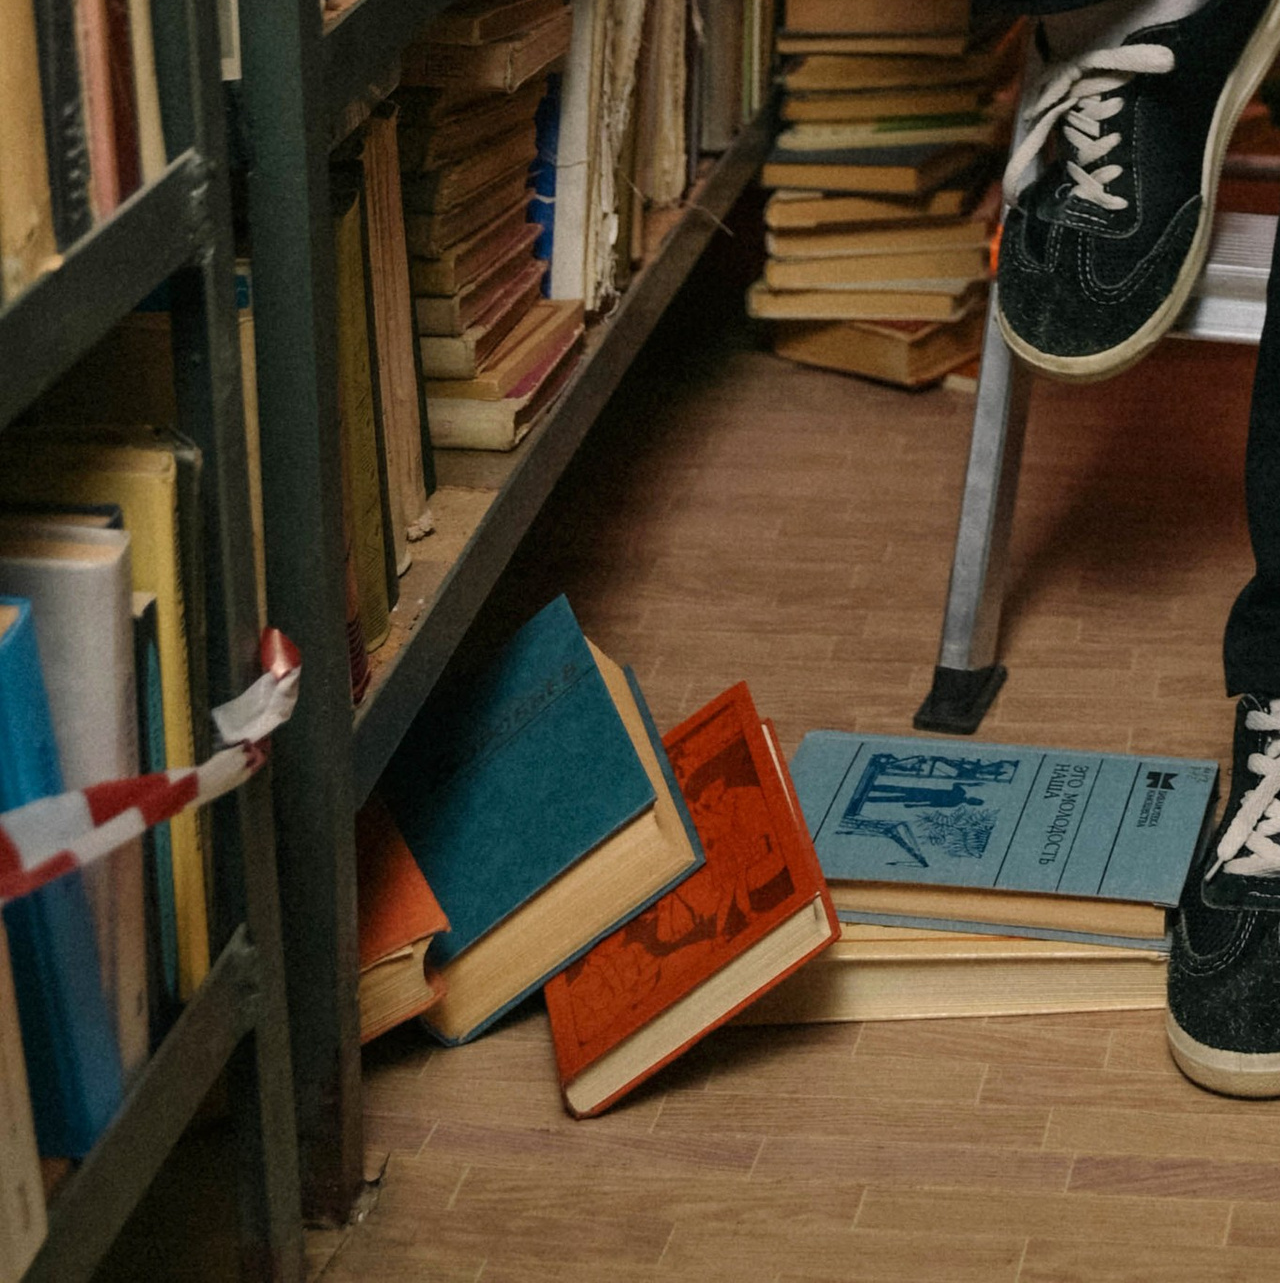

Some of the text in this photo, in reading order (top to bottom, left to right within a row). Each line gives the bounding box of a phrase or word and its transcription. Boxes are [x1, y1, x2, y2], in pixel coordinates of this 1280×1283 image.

[1038, 764, 1090, 866] ЭТО МОЛОДОСТЬ
[1043, 763, 1072, 799] НАША
